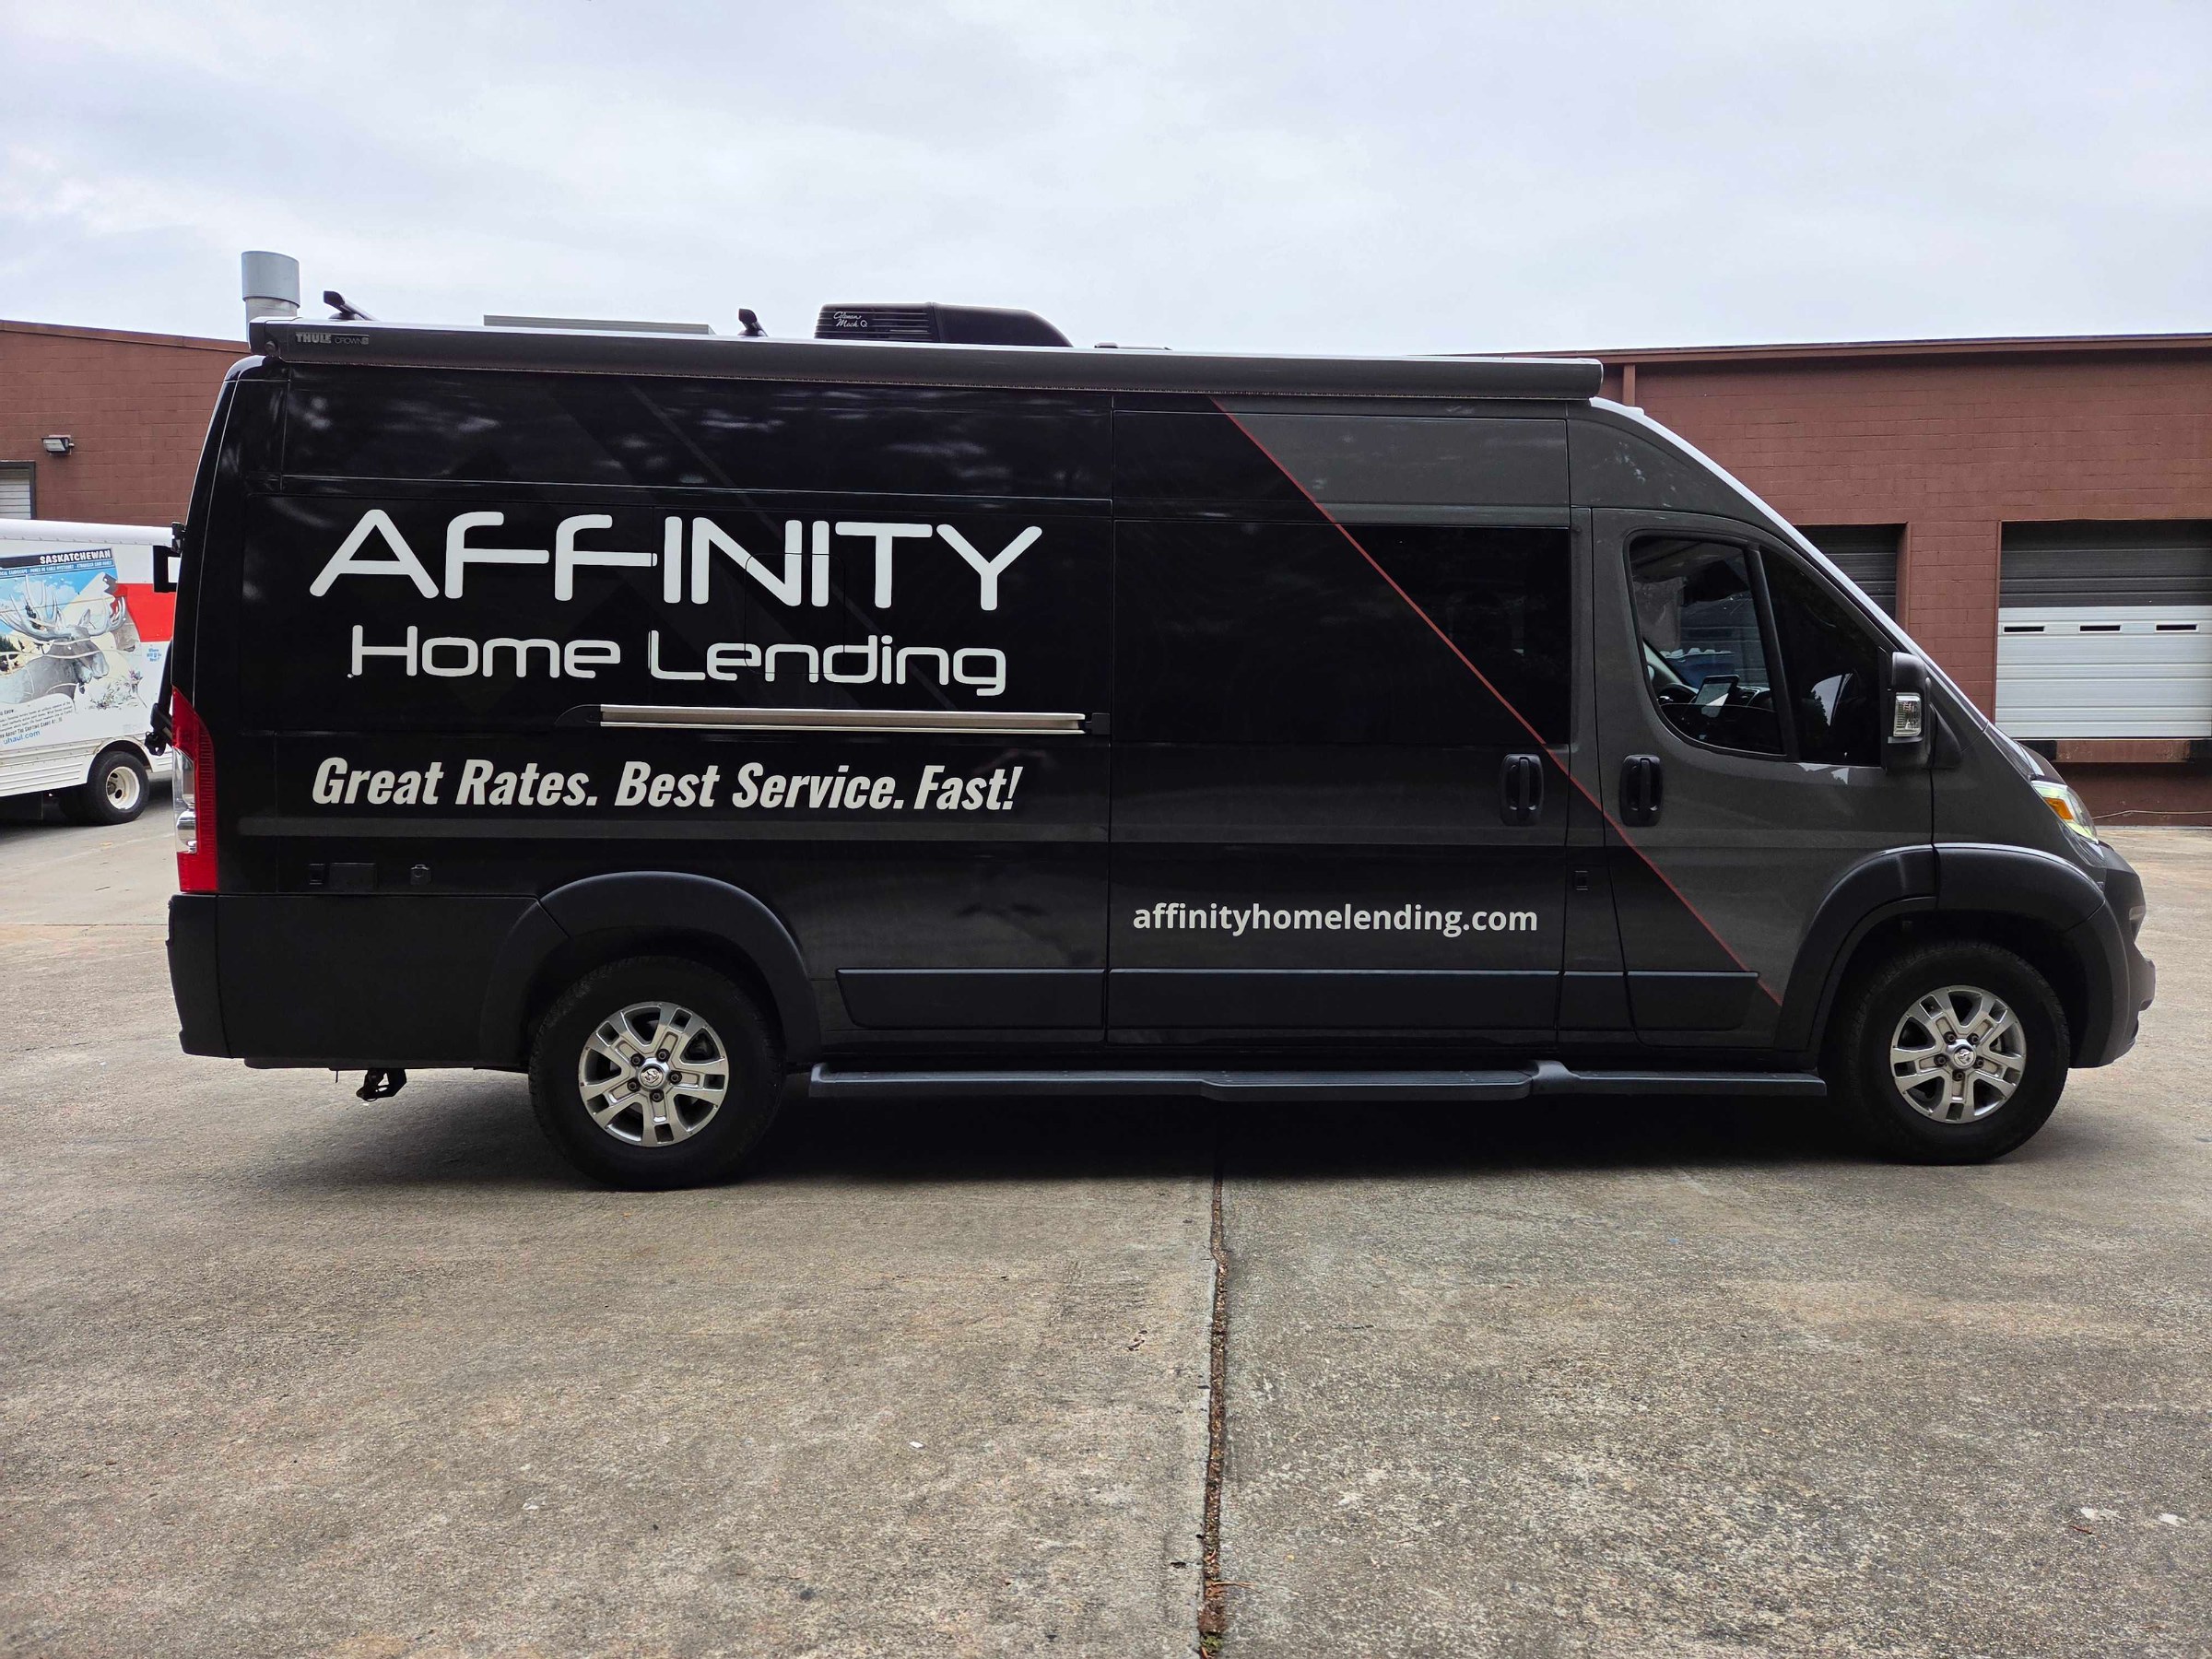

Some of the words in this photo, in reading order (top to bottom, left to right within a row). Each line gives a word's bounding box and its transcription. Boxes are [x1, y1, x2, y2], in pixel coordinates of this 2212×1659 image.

[296, 333, 332, 344] THULE
[40, 549, 112, 564] SASKATCHEWAN
[352, 625, 621, 679] Home
[647, 630, 1006, 697] Lending
[4, 730, 40, 744] uhaul.com
[312, 758, 444, 805] Great
[455, 759, 598, 806] Rates.
[614, 761, 721, 807] Best
[733, 763, 904, 809] Service.
[913, 765, 1024, 811] Fast!
[1133, 902, 1537, 938] affinityhomelending.com
